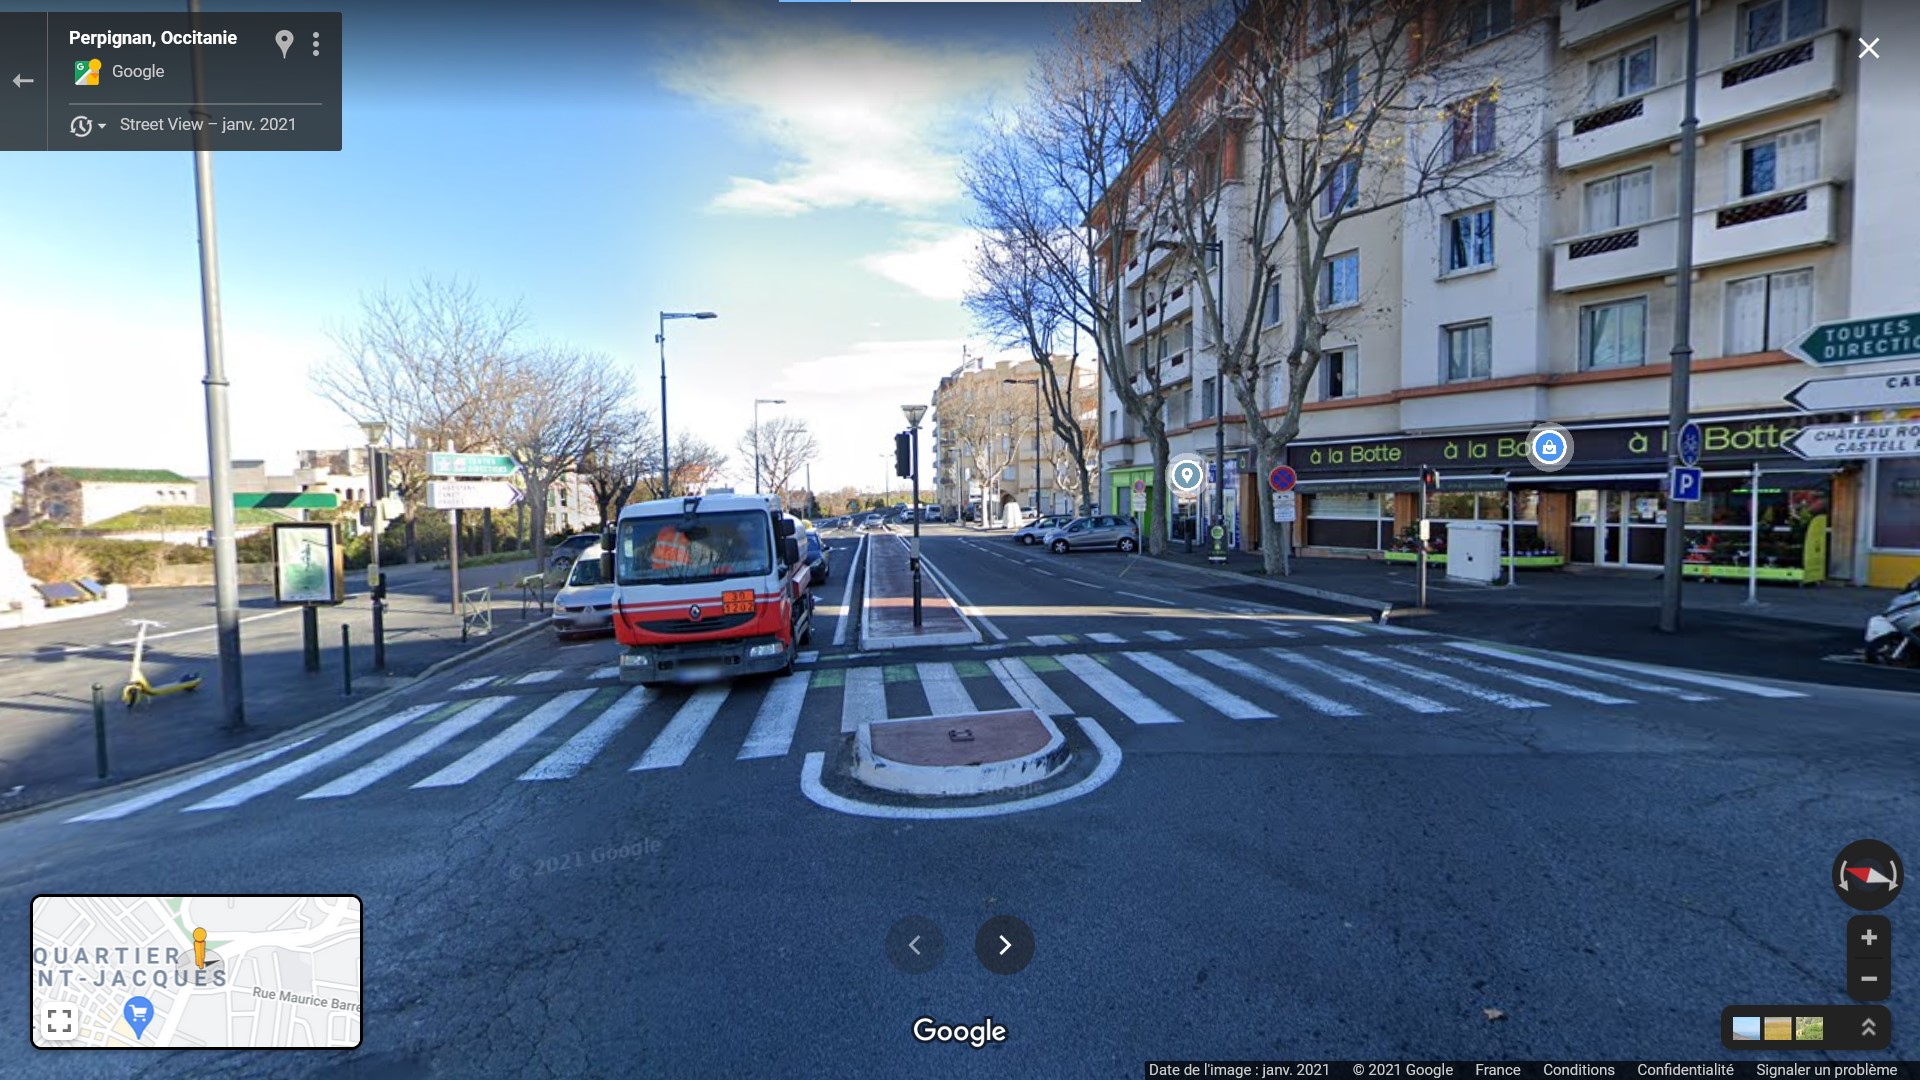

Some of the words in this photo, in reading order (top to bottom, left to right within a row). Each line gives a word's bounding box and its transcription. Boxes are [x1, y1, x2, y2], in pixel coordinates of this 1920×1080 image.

[1825, 319, 1911, 342] TOUTES
[1443, 441, 1458, 460] à
[1468, 440, 1487, 459] la
[1629, 432, 1648, 453] à
[1662, 430, 1668, 452] l
[1834, 439, 1906, 454] CASTELL
[1310, 448, 1322, 465] à
[1328, 447, 1343, 464] la
[1351, 443, 1402, 463] Botte
[1680, 473, 1694, 494] P
